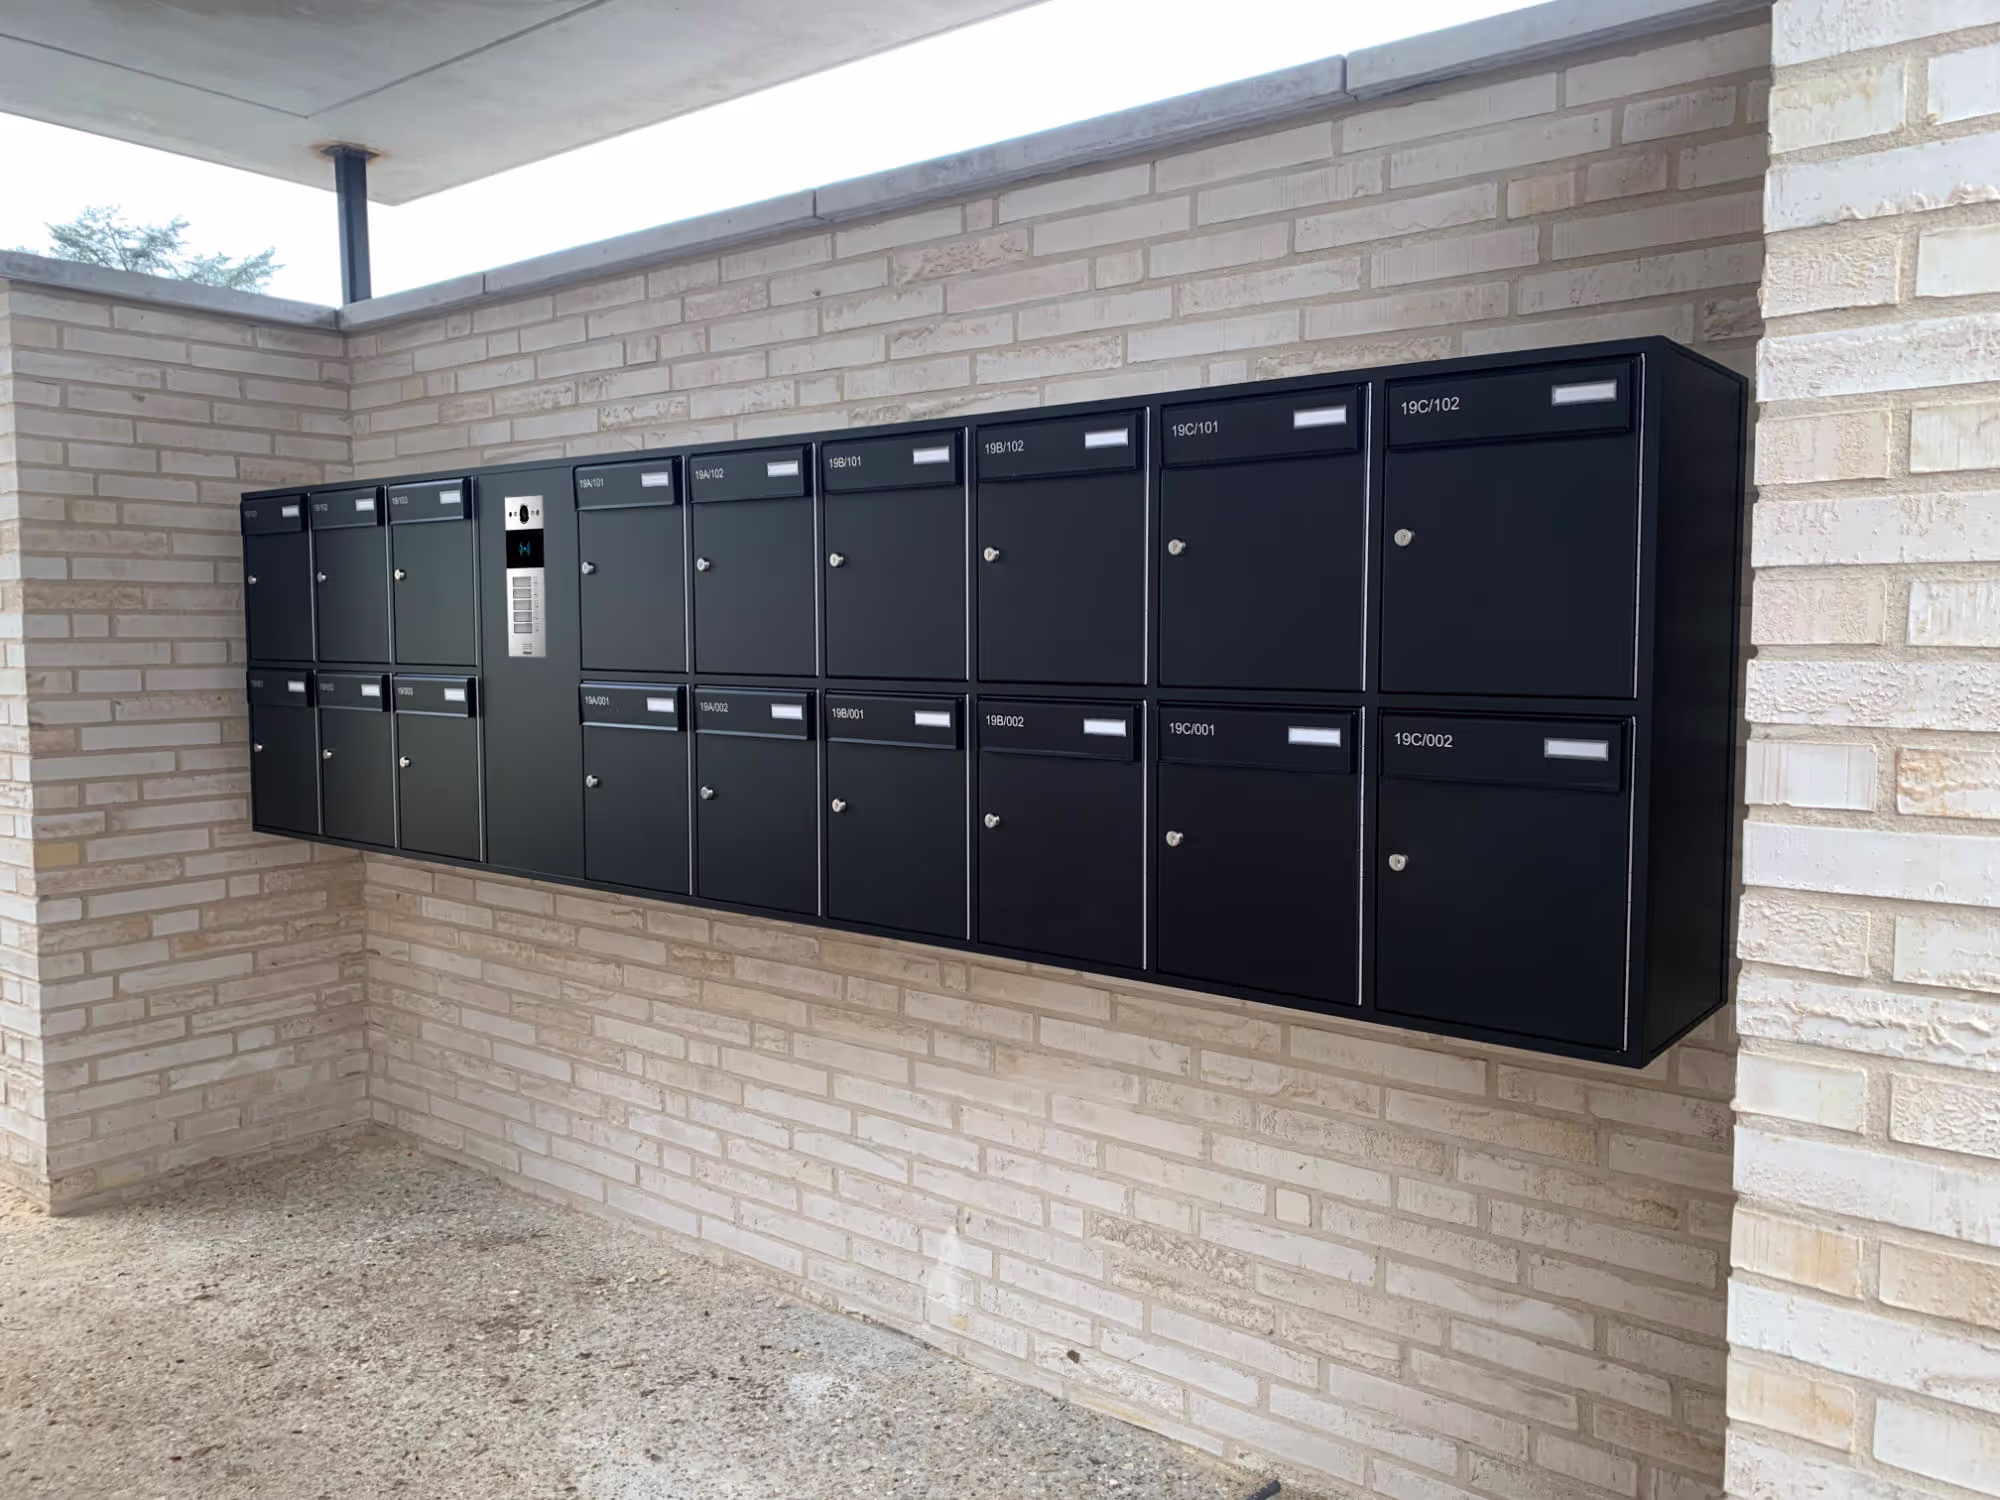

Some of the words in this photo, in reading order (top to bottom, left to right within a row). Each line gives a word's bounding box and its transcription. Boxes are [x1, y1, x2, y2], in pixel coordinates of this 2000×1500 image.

[1401, 396, 1460, 416] 19C/102
[1171, 420, 1218, 437] 19C/101
[984, 440, 1025, 455] 19B/102
[828, 456, 862, 469] 19B/101
[695, 467, 725, 480] 19A/102
[579, 478, 604, 489] 19A/101
[584, 695, 610, 706] 19A/001
[699, 701, 729, 713] 19A/002
[831, 707, 865, 720] 19B/001
[985, 714, 1025, 728] 19B/002
[1168, 722, 1216, 736] 19C/001
[1394, 732, 1453, 749] 19C/002
